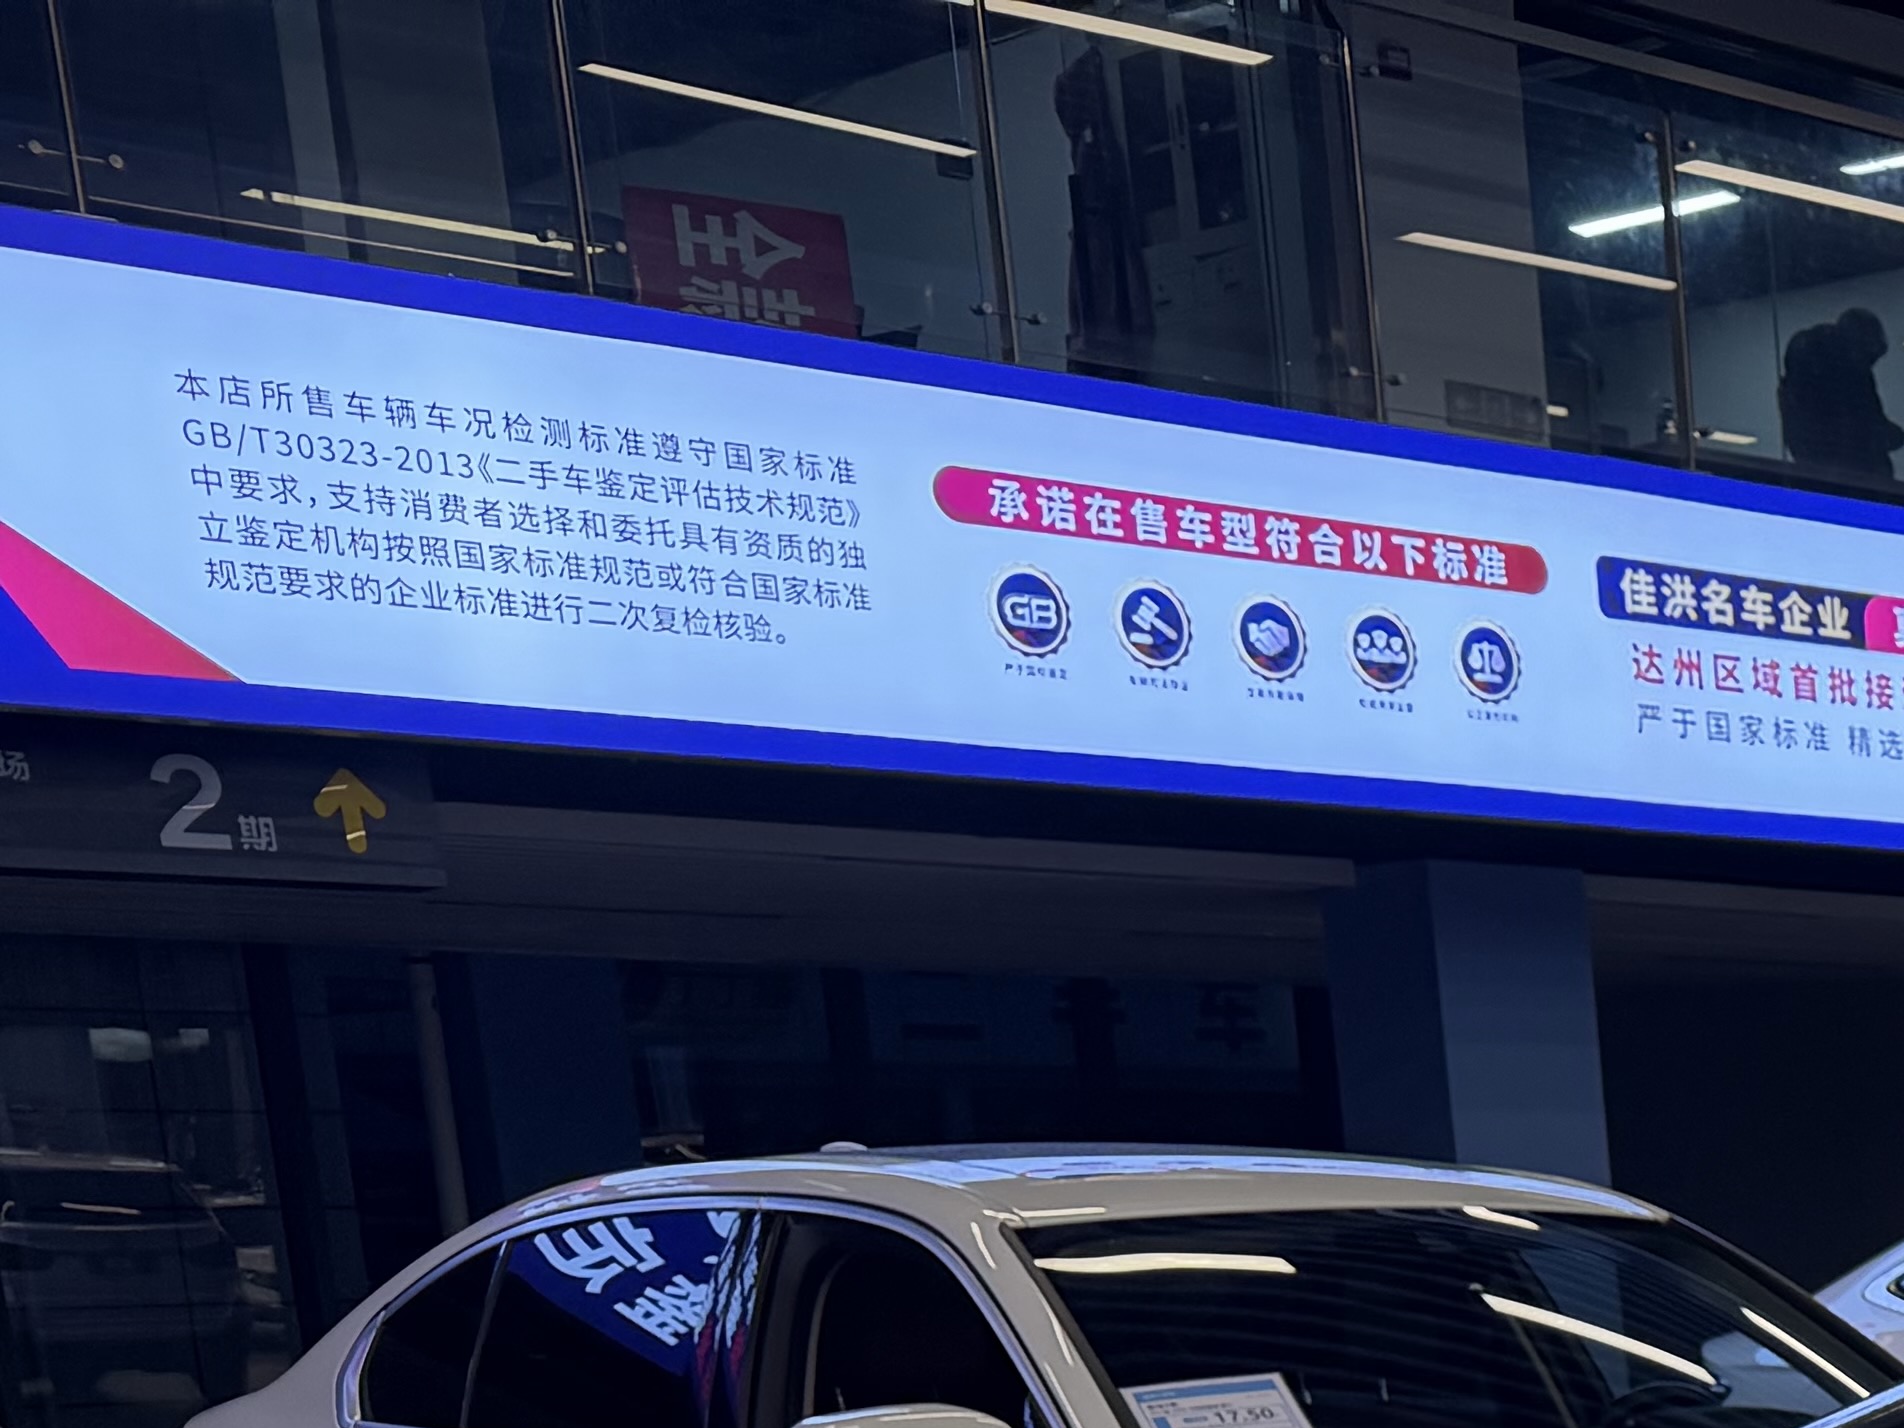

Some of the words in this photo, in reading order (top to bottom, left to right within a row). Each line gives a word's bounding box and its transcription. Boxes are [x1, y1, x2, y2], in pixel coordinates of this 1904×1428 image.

[174, 368, 858, 485] 本店所售车辆车况检测标准遵守国家标准
[183, 419, 861, 528] GB/T30323-2013《二手车鉴定评估技术规范》
[191, 464, 867, 570] 中要求，支持消费者选择和委托具有资质的独
[198, 511, 872, 611] 立鉴定机构按照国家标准规范或符合国家标准
[987, 478, 1508, 588] 承诺在售车型符合以下标准
[205, 558, 788, 645] 规范要求的企业标准进行二次复检核验。
[1619, 567, 1852, 641] 佳洪名车企业
[1637, 703, 1831, 752] 严于国家标准
